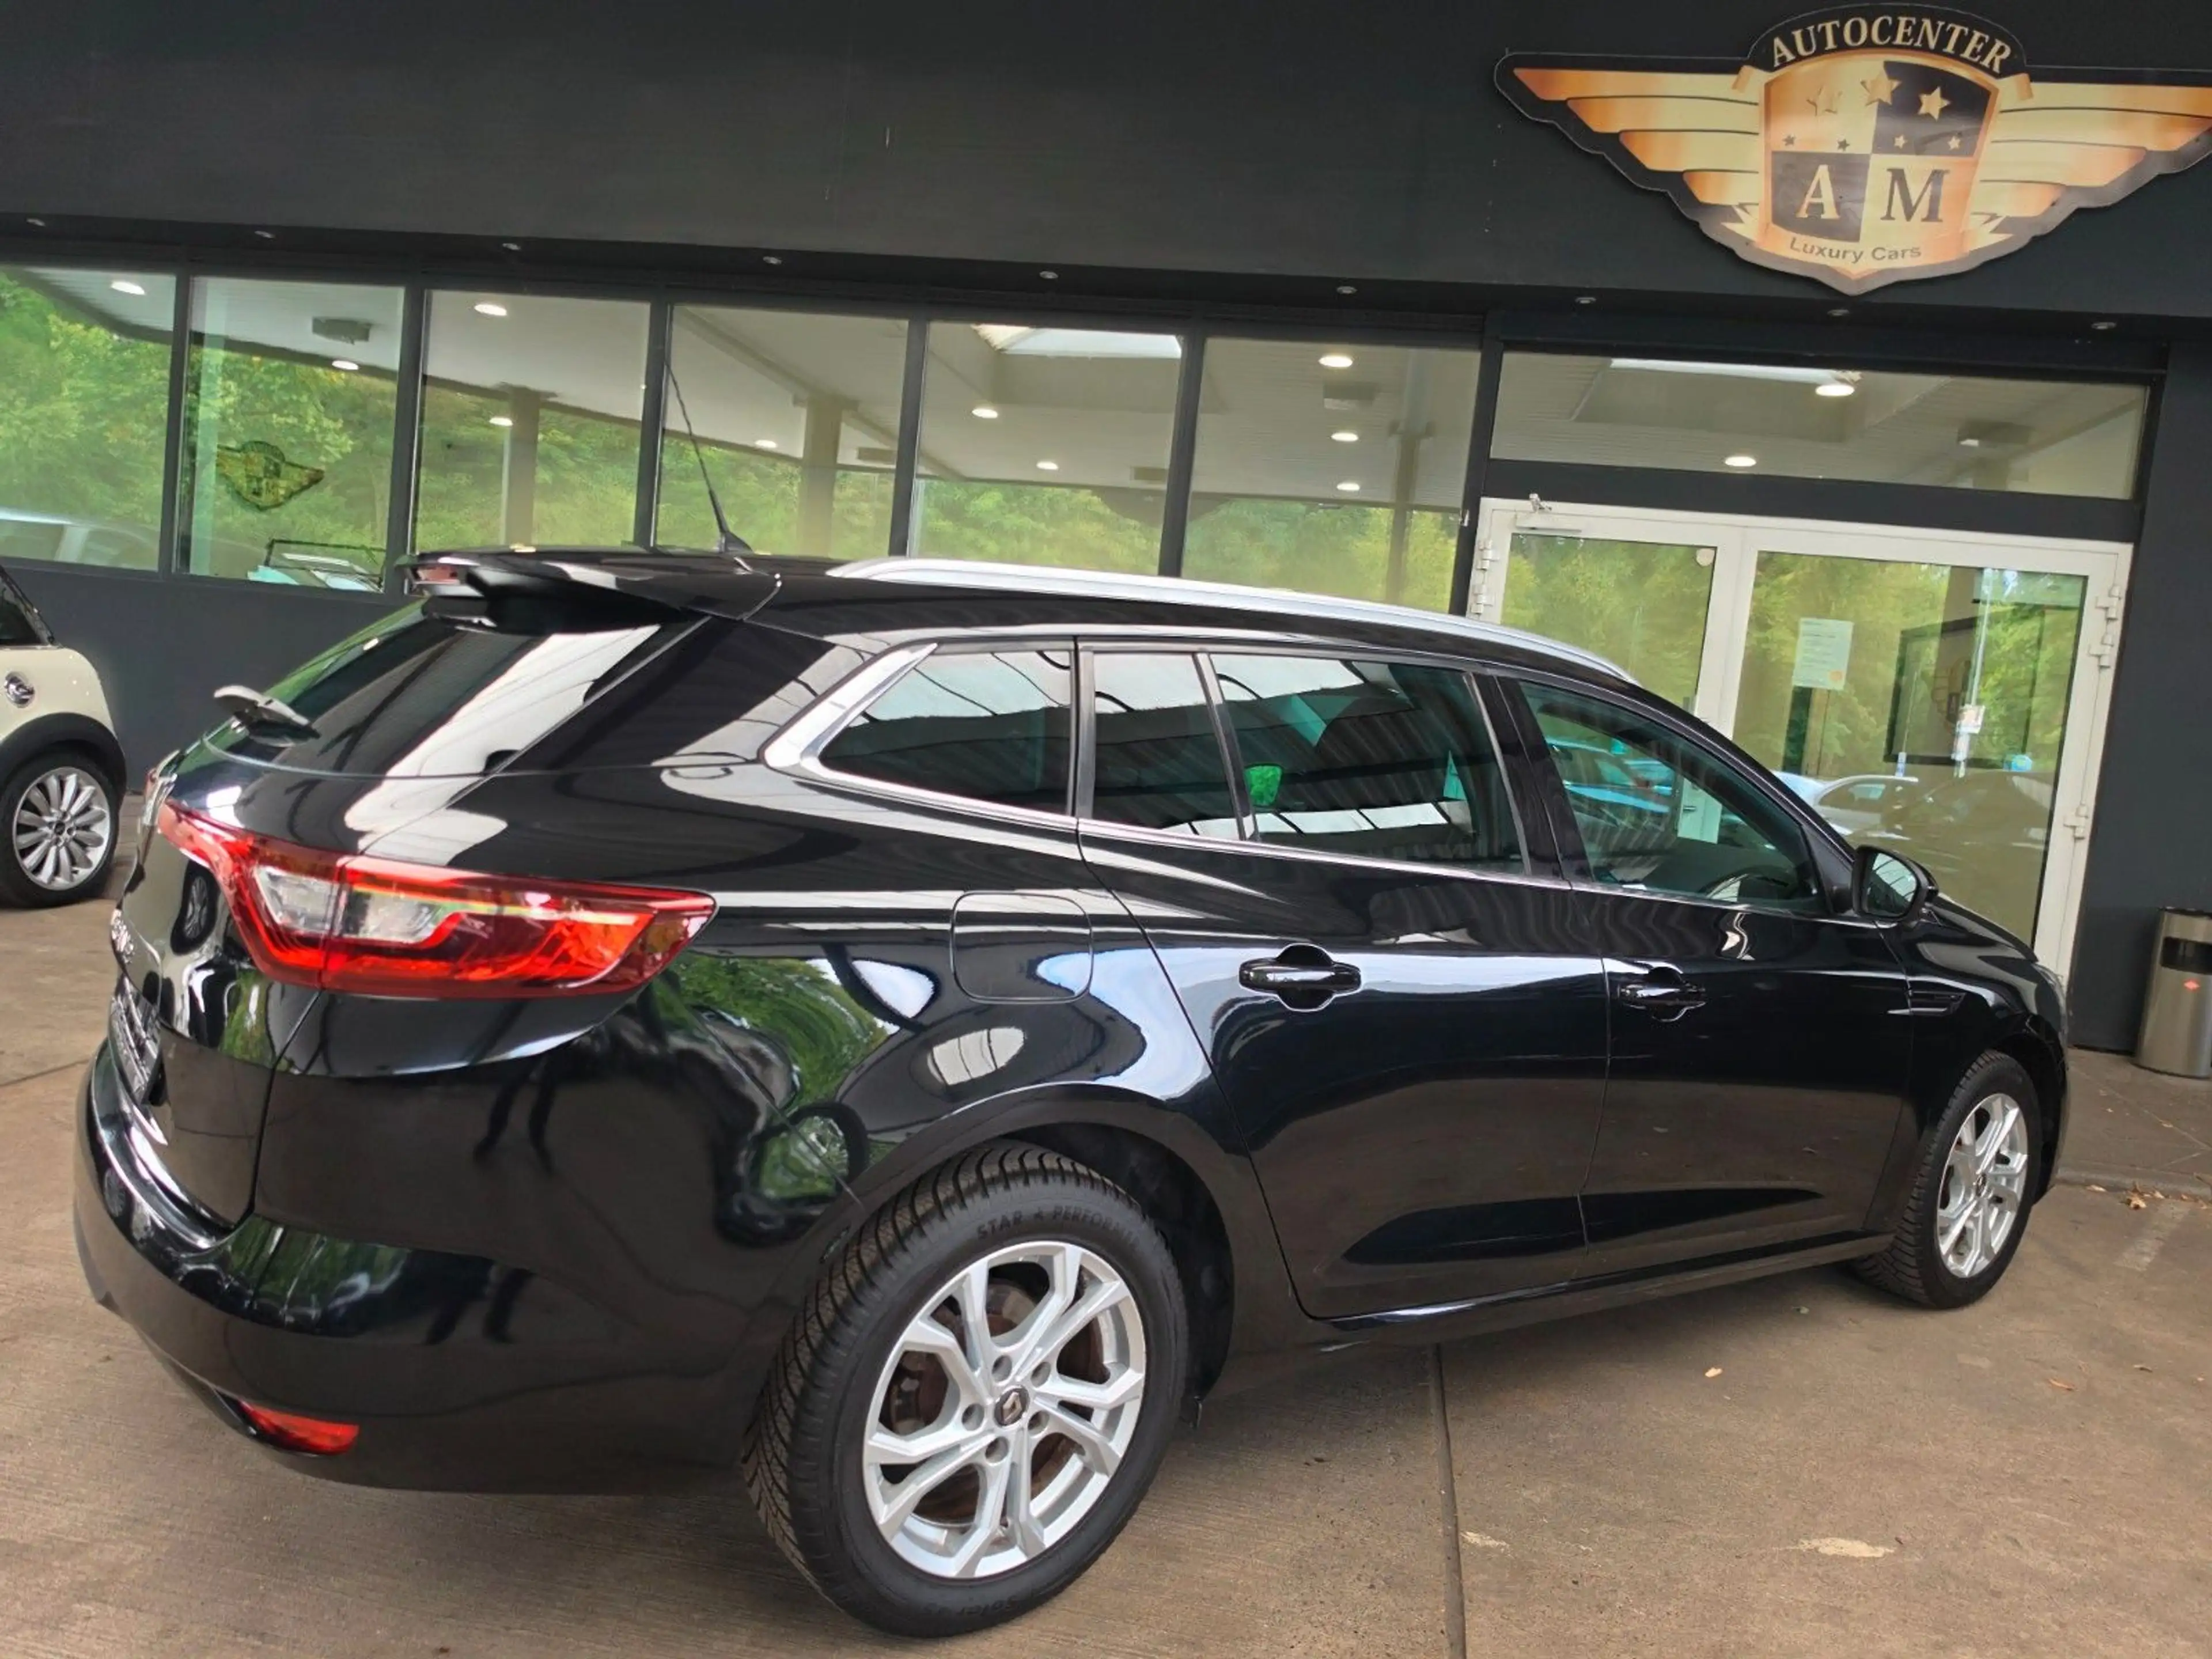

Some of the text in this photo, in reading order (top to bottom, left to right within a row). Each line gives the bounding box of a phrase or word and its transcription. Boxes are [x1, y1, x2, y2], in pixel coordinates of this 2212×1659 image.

[1772, 16, 2012, 74] AUTOCENTER
[1795, 164, 1950, 223] A M
[1789, 237, 1922, 264] Luxury Cars
[977, 1210, 1023, 1238] STAR
